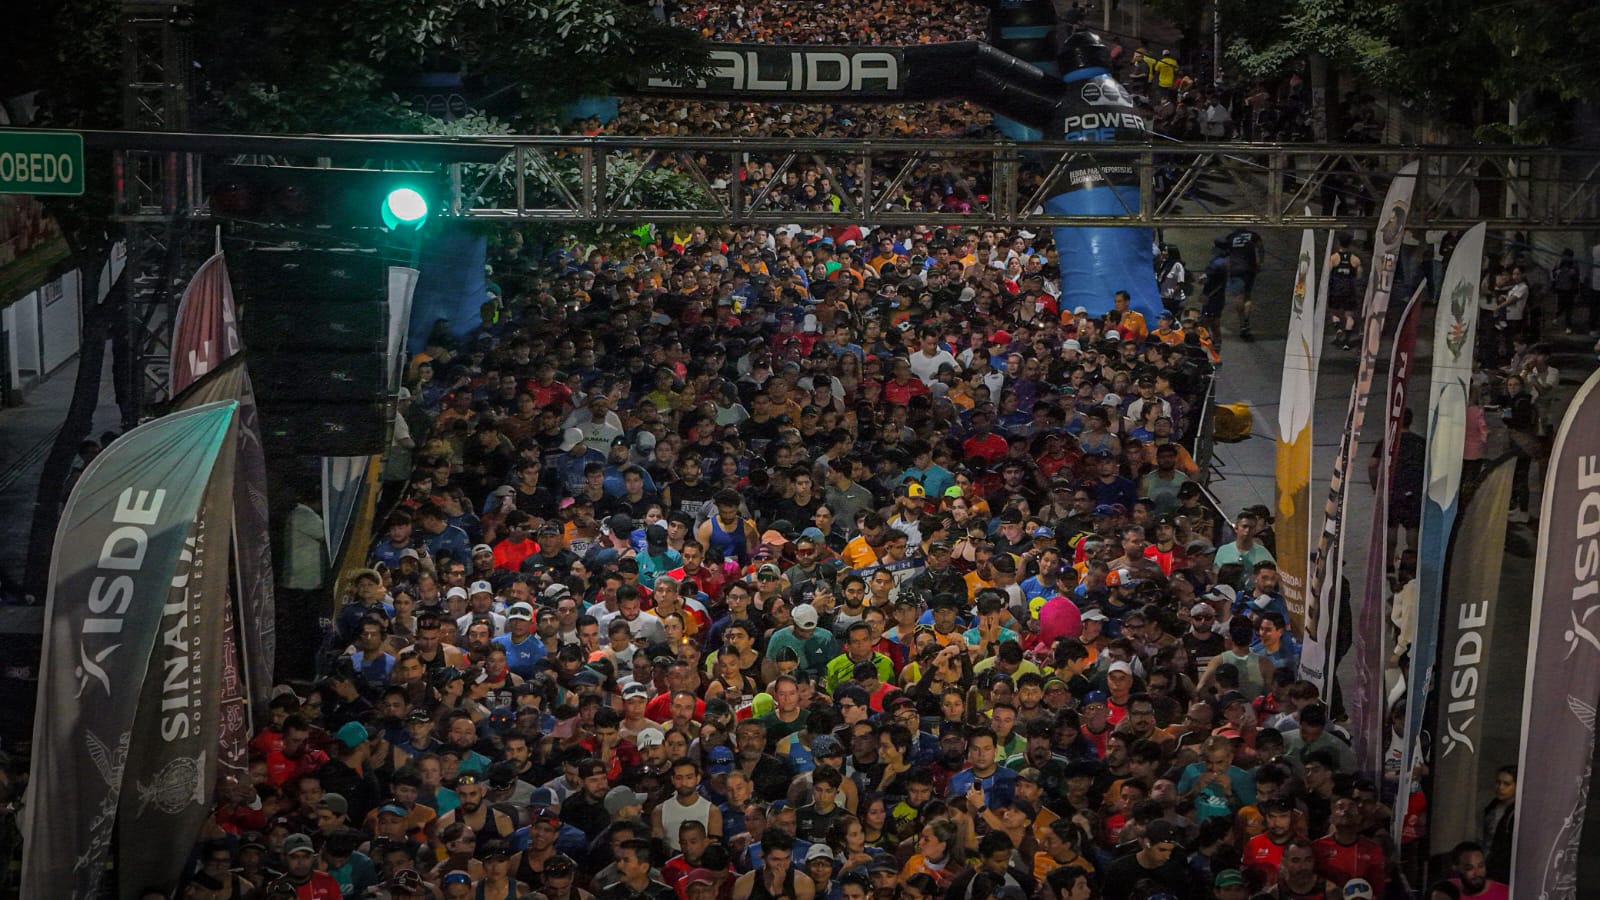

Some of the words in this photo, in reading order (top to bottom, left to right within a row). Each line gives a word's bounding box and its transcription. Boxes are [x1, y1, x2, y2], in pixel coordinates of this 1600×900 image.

[647, 51, 898, 91] ALIDA
[1064, 112, 1145, 134] POWER
[0, 152, 73, 184] OBEDO
[81, 486, 167, 634] ISDE
[161, 513, 197, 744] SINALO
[193, 590, 203, 624] DEL
[192, 635, 202, 736] GOBIERNO
[1447, 600, 1489, 714] ISDE
